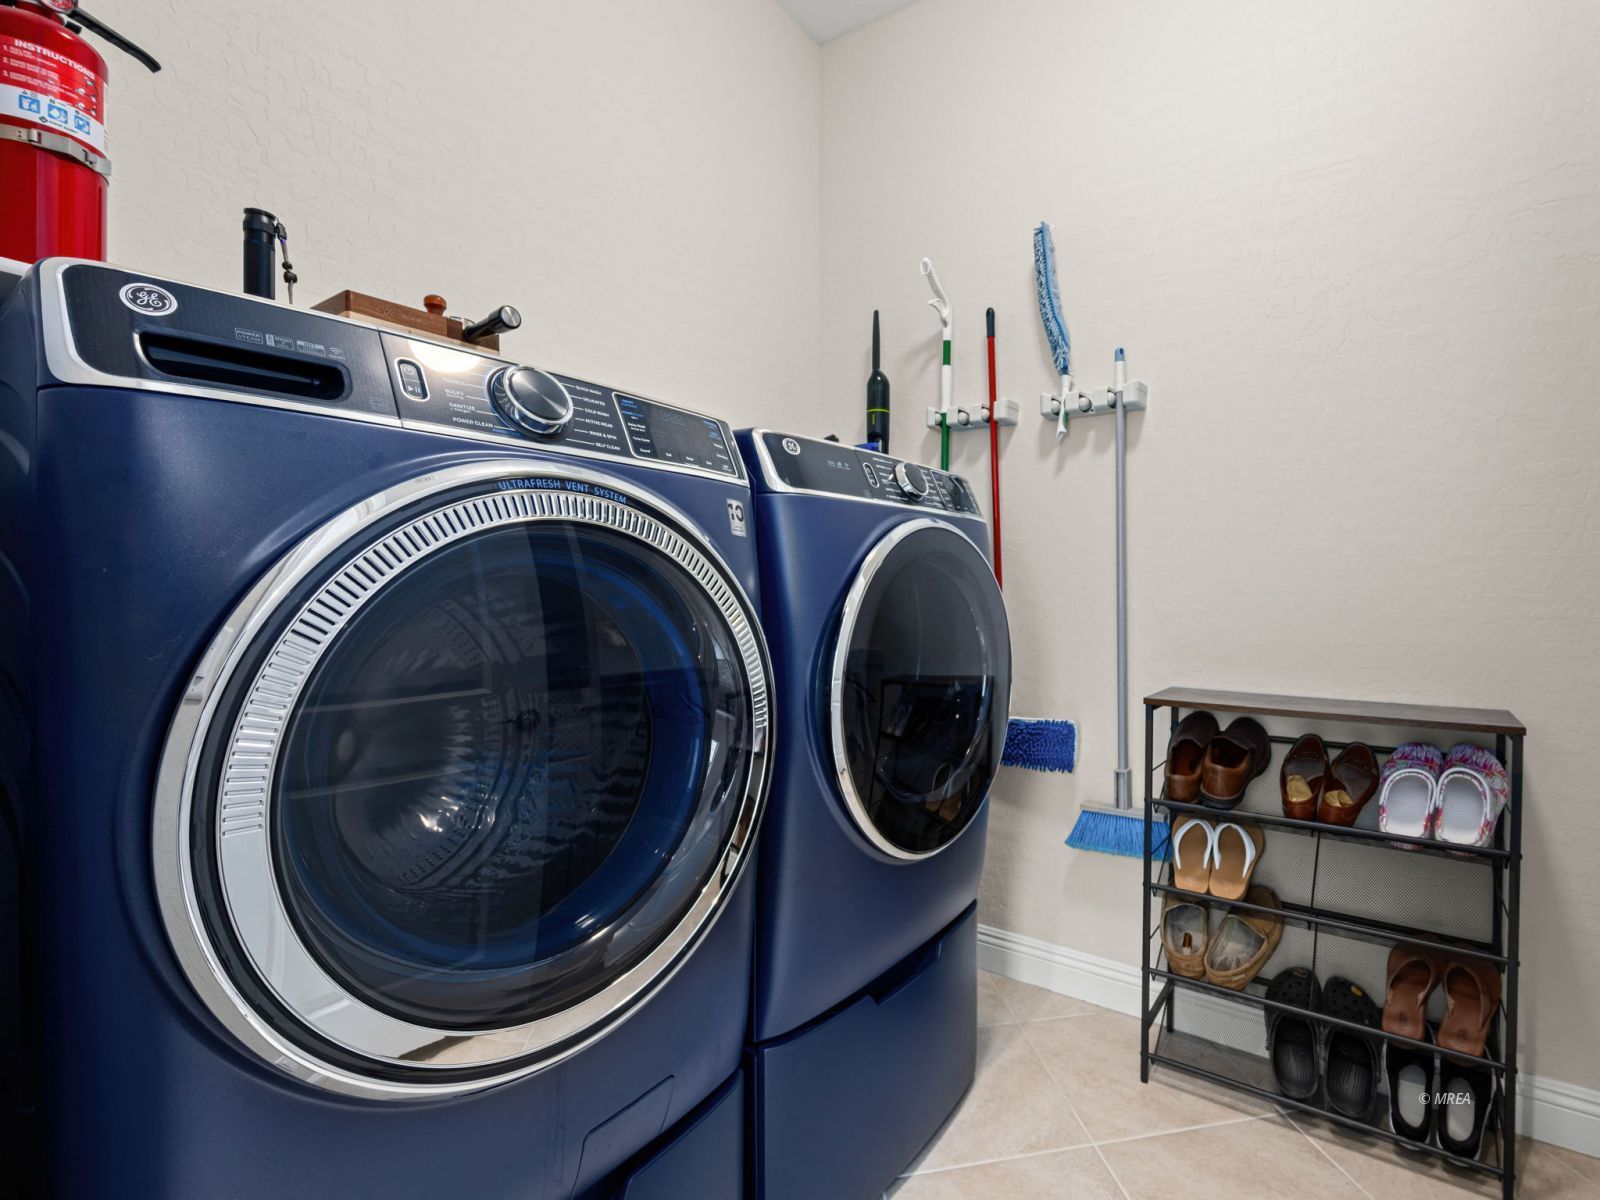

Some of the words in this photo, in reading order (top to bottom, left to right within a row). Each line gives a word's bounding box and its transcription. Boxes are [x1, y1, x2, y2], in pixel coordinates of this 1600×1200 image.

[14, 38, 95, 80] INSTRUCTIONS
[448, 402, 476, 411] SANITIZE
[452, 416, 474, 426] POWER
[474, 420, 494, 428] CLEAN
[498, 478, 561, 490] ULTRAFRESH
[565, 481, 590, 493] VENT
[594, 486, 627, 504] SYSTEM
